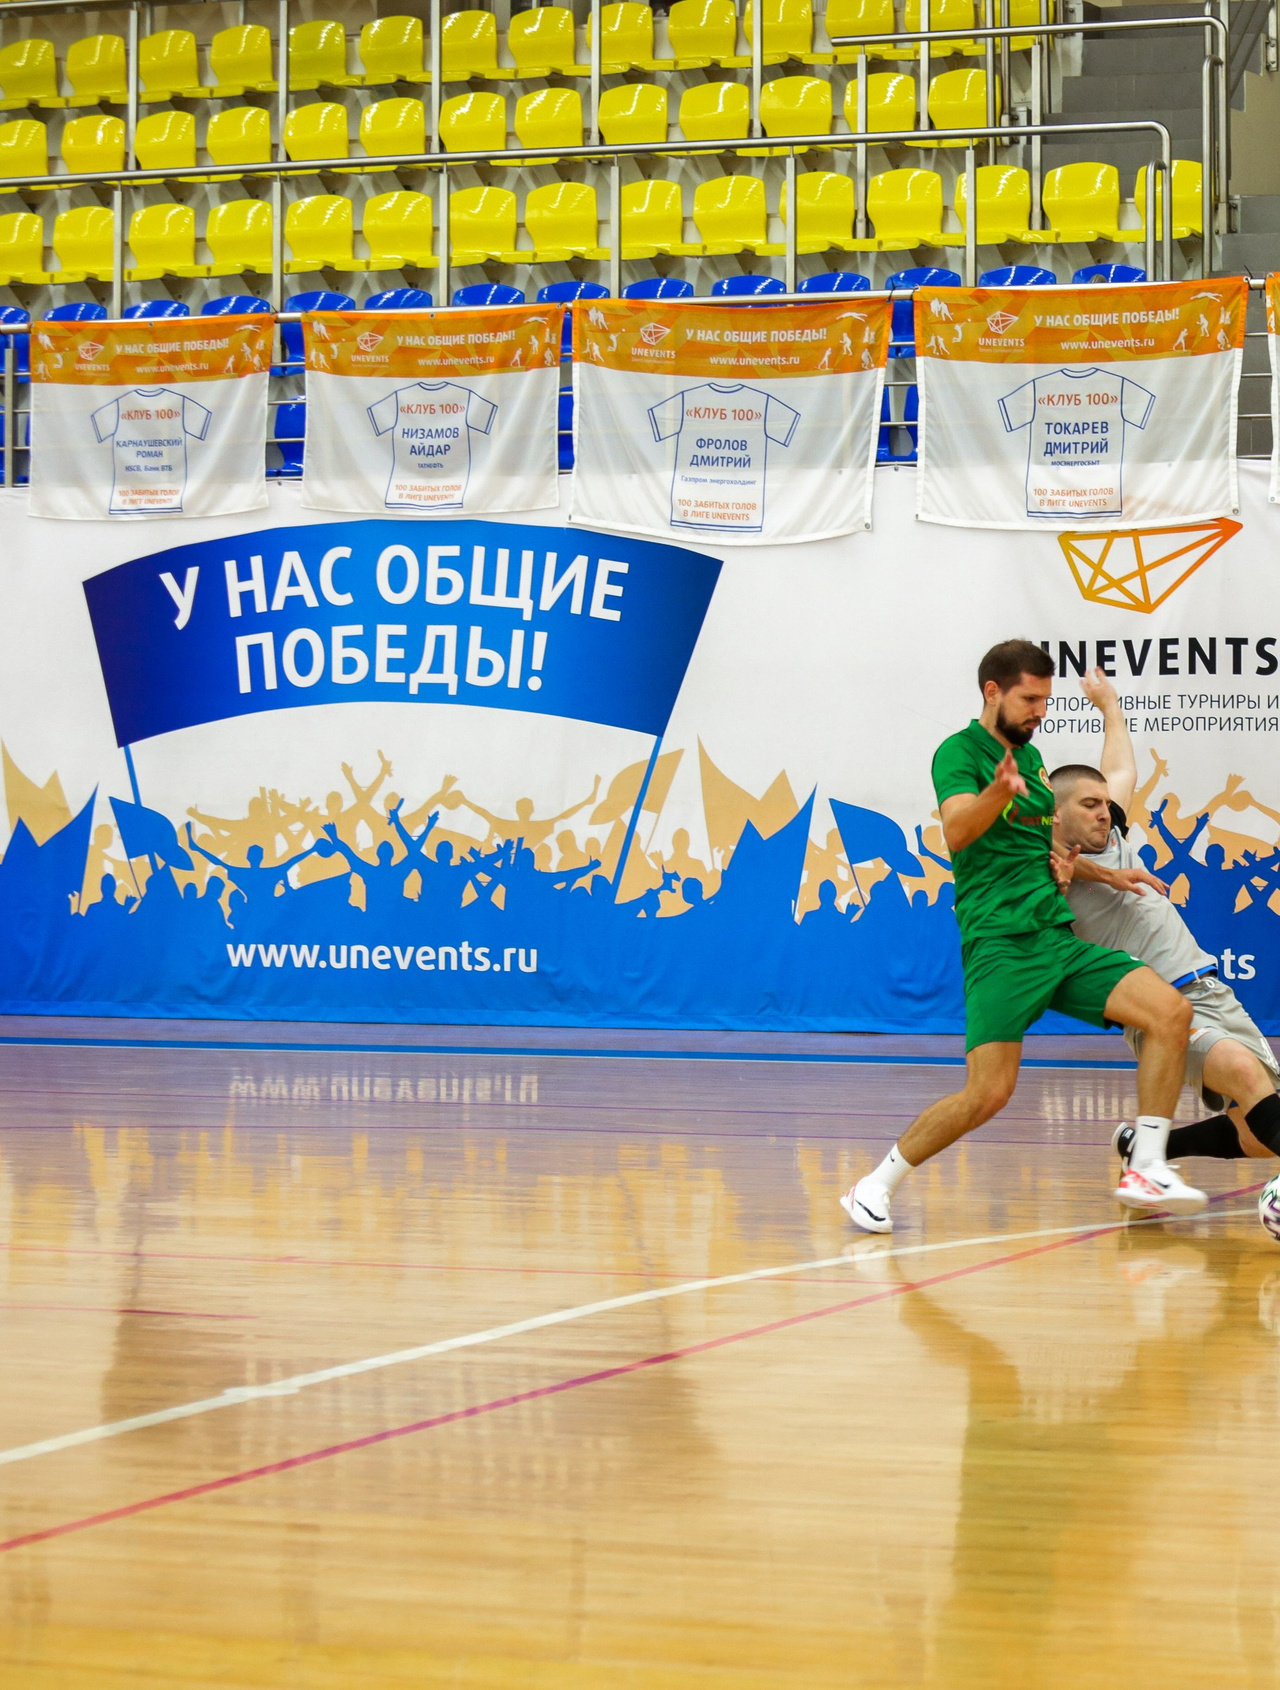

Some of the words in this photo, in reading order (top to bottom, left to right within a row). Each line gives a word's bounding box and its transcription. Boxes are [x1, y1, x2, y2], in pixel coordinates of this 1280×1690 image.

[1033, 314, 1043, 327] У
[1046, 314, 1070, 327] НАС
[1073, 312, 1120, 328] ОБЩИЕ
[1122, 308, 1180, 324] ПОБЕДЫ!
[397, 336, 404, 346] У
[405, 335, 425, 346] НАС
[427, 333, 466, 347] ОБЩИЕ
[467, 330, 516, 344] ПОБЕДЫ!
[685, 328, 694, 340] У
[696, 329, 721, 342] НАС
[724, 330, 768, 345] ОБЩИЕ
[770, 328, 827, 343] ПОБЕДЫ!
[978, 337, 1025, 347] UNEVENTS
[115, 344, 124, 355] У
[125, 343, 145, 355] НАС
[146, 341, 181, 355] ОБЩИЕ
[183, 337, 229, 352] ПОБЕДЫ!
[1060, 338, 1155, 350] www.unevents.ru
[351, 355, 389, 363] UNEVENTS
[631, 347, 677, 359] UNEVENTS
[418, 356, 495, 367] www.unevents.ru
[709, 355, 800, 366] www.unevents.ru
[136, 362, 209, 374] www.unevents.ru
[1038, 394, 1082, 407] «КЛУБ
[1086, 393, 1119, 406] 100»
[121, 409, 152, 420] «КЛУБ
[155, 408, 181, 420] 100»
[400, 404, 436, 415] «КЛУБ
[439, 403, 466, 414] 100»
[686, 407, 727, 420] «КЛУБ
[731, 409, 762, 421] 100»
[402, 427, 460, 439] НИЗАМОВ
[1045, 421, 1109, 435] ТОКАРЕВ
[116, 437, 183, 448] КАРНАУШЕВСКИЙ
[696, 438, 748, 451] ФРОЛОВ
[1043, 438, 1109, 457] ДМИТРИЙ
[136, 450, 163, 458] РОМАН
[409, 443, 451, 457] АЙДАР
[689, 454, 751, 468] ДМИТРИЙ
[681, 475, 708, 484] Газпром
[1050, 489, 1087, 497] ЗАБИТЫХ
[1089, 488, 1114, 496] ГОЛОВ
[678, 499, 692, 507] 100
[694, 501, 730, 510] ЗАБИТЫХ
[731, 502, 757, 510] ГОЛОВ
[1047, 499, 1066, 507] ЛИГЕ
[1069, 498, 1107, 507] UNEVENTS
[690, 510, 710, 519] ЛИГЕ
[711, 511, 750, 521] UNEVENTS
[159, 566, 200, 630] У
[224, 546, 354, 618] НАС
[375, 544, 629, 622] ОБЩИЕ
[235, 624, 548, 695] ПОБЕДЫ!
[1026, 637, 1279, 678] NEVENTS
[1177, 694, 1261, 710] ТУРНИРЫ
[1267, 695, 1279, 710] И
[1144, 716, 1279, 733] МЕРОПРИЯТИЯ
[1021, 816, 1054, 826] TATNE
[226, 940, 538, 973] www.unevents.ru
